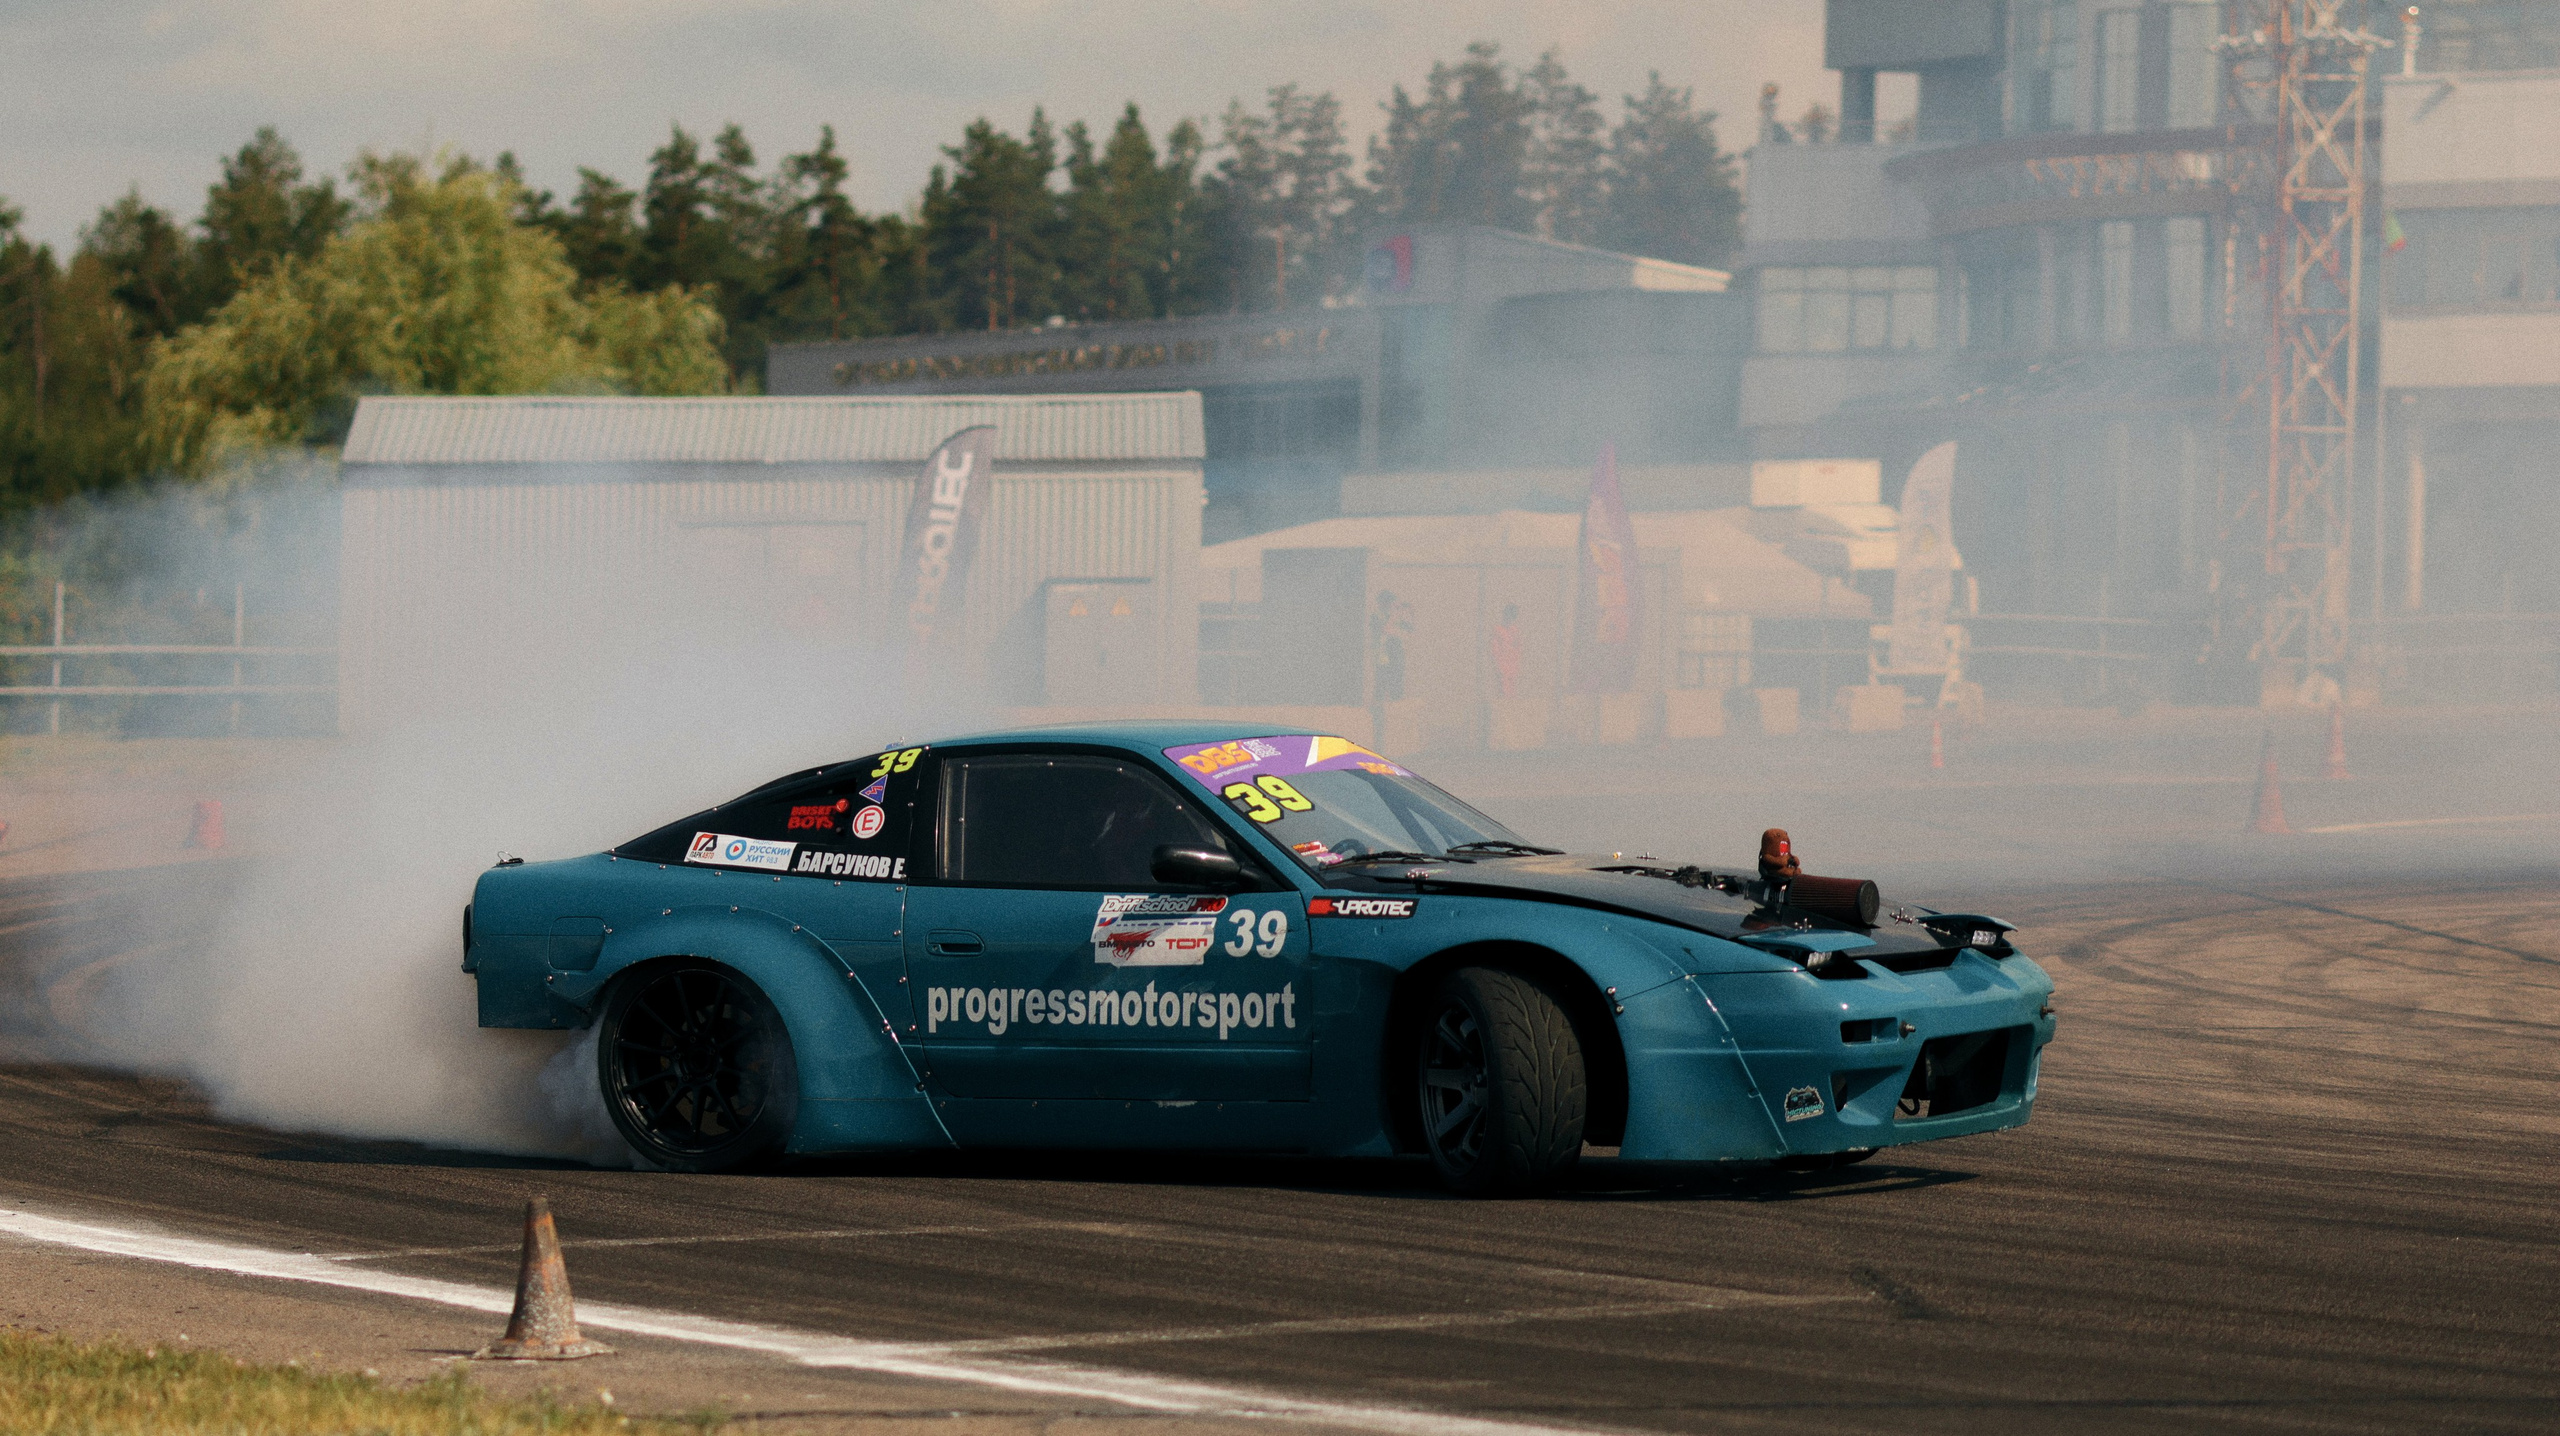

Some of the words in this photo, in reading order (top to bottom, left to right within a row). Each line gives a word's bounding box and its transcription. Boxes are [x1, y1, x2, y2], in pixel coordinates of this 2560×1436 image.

[871, 748, 922, 778] 39
[1222, 774, 1315, 823] 39
[745, 854, 765, 864] ХИТ
[796, 851, 892, 878] БАРСУКОВ
[1224, 909, 1289, 959] 39
[927, 980, 1297, 1040] progressmotorsport
